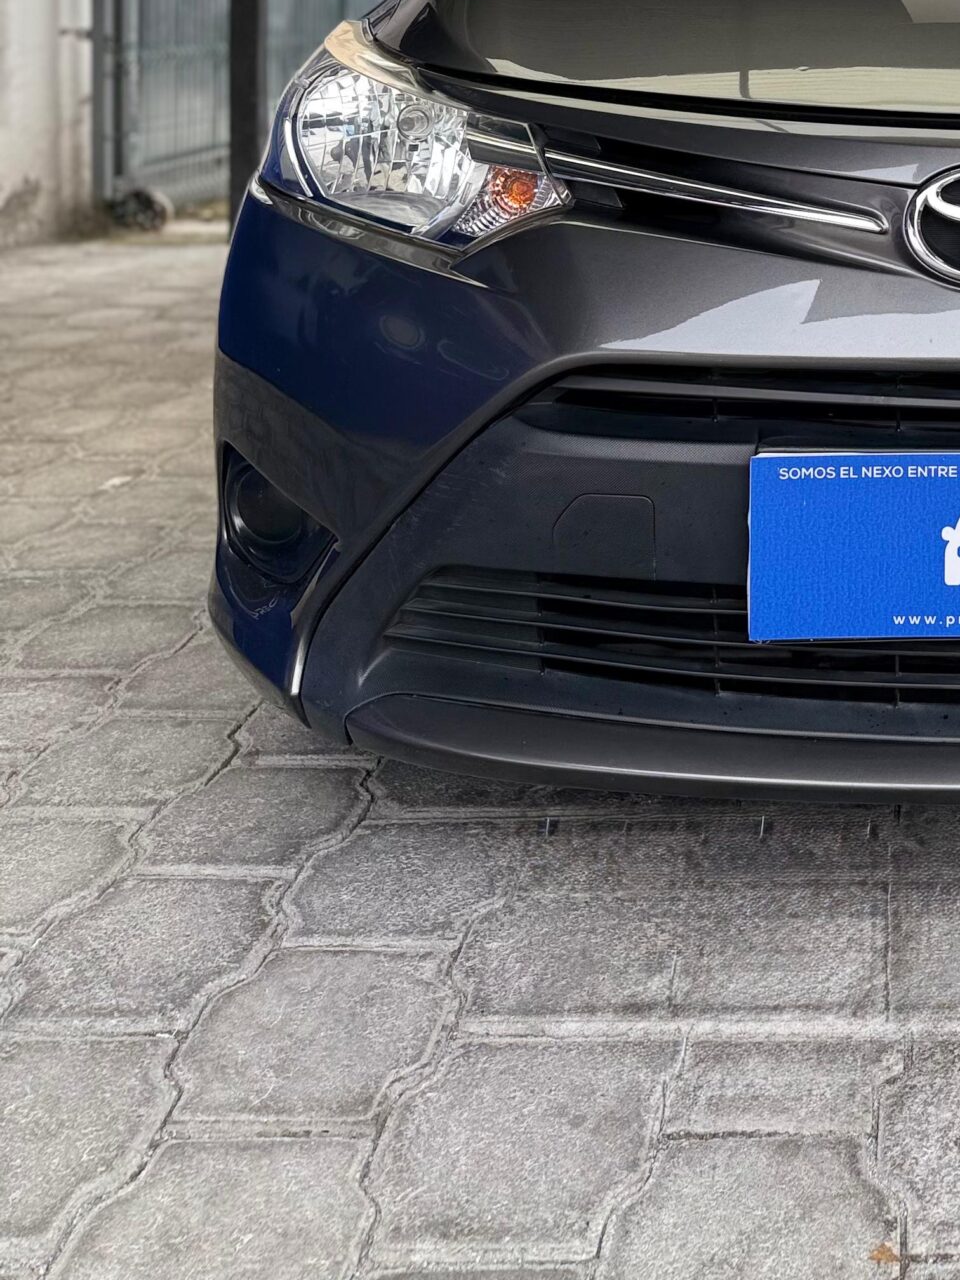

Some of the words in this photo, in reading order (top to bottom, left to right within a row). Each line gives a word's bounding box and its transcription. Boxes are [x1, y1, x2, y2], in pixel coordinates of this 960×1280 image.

[778, 467, 836, 480] SOMOS
[839, 467, 858, 478] EL
[861, 466, 904, 479] NEXO
[907, 466, 958, 478] ENTRE
